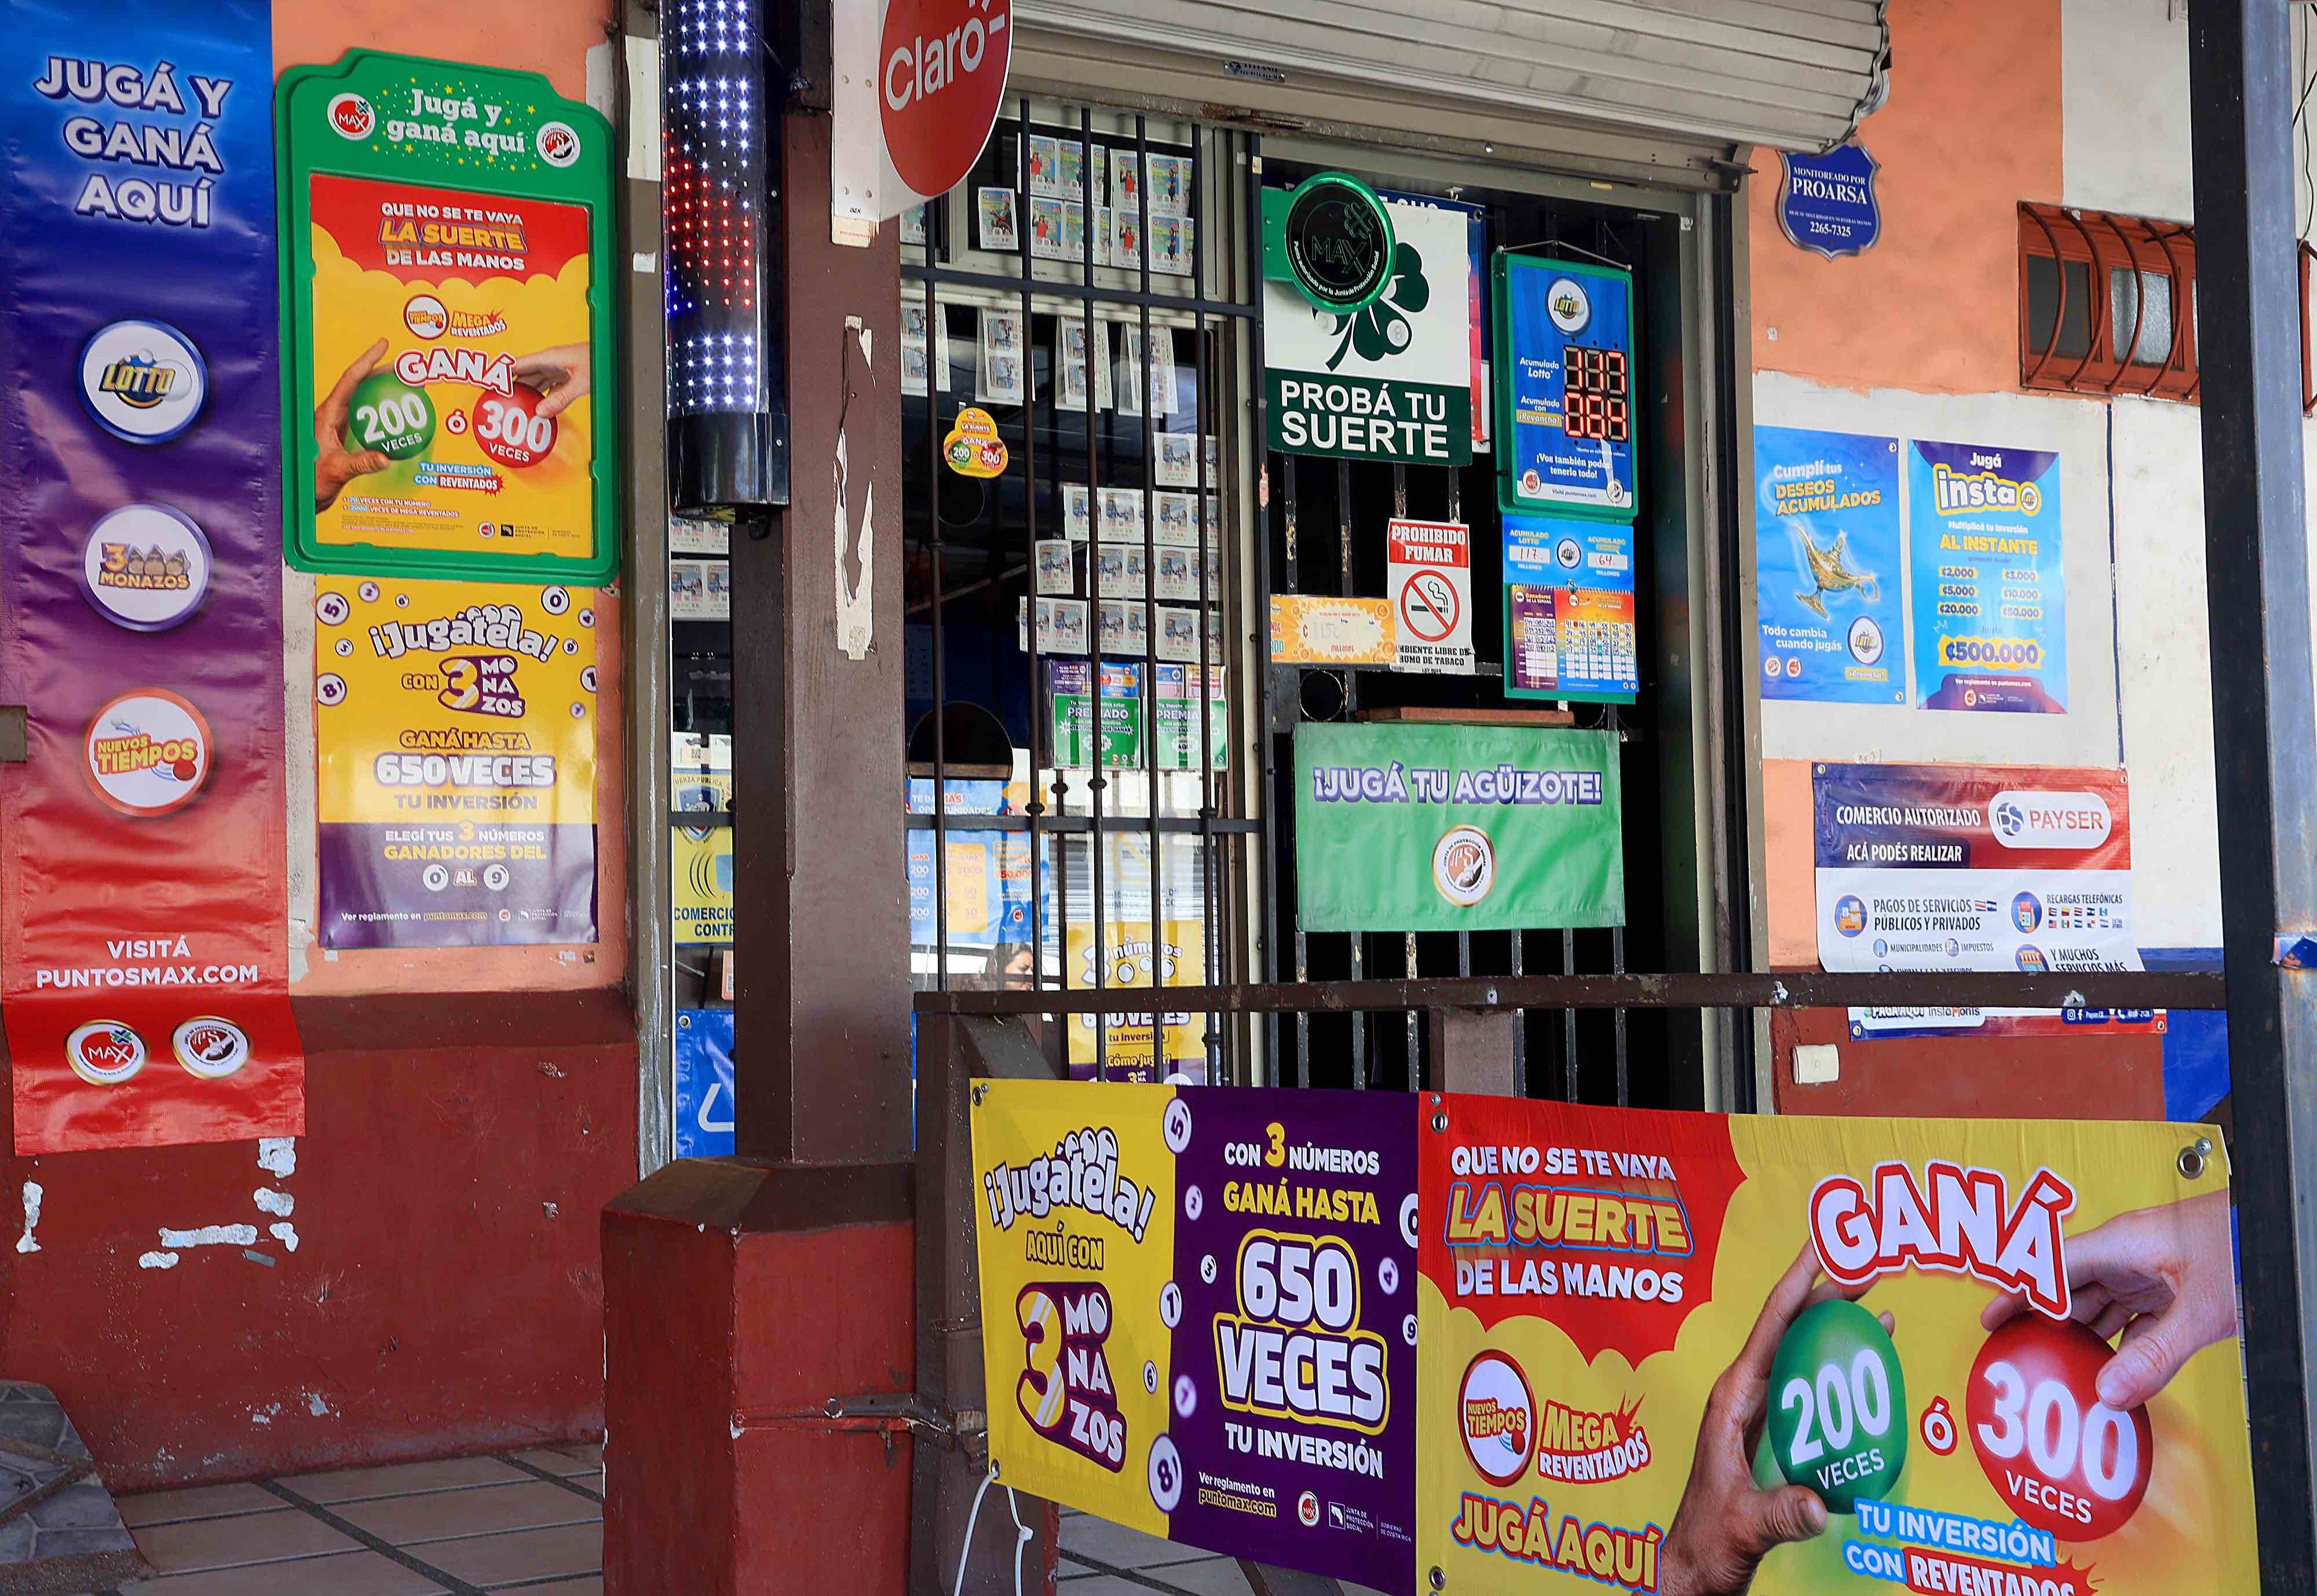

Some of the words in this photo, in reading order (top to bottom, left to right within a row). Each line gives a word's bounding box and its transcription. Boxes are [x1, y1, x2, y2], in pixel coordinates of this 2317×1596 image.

[885, 17, 986, 112] Claro
[35, 56, 184, 114] JUGÁ
[187, 76, 233, 119] Y
[411, 87, 478, 121] Jugá
[484, 103, 502, 128] y
[339, 113, 366, 131] MAX
[63, 117, 225, 174] GANÁ
[387, 118, 458, 145] ganá
[465, 129, 525, 156] aquí
[1794, 166, 1849, 182] MONITOREADO
[1850, 174, 1866, 185] POR
[76, 174, 214, 228] AQUÍ
[1792, 177, 1868, 205] PROARSA
[381, 203, 414, 217] QUE
[416, 204, 440, 218] NO
[442, 206, 462, 220] SE
[465, 208, 483, 222] TE
[486, 210, 523, 225] VAYA
[381, 220, 418, 244] LA
[422, 222, 525, 251] SUERTE
[1810, 221, 1851, 238] 2265-7325
[387, 249, 413, 265] DE
[415, 250, 453, 266] LAS
[456, 253, 525, 271] MANOS
[1311, 235, 1367, 276] MAX
[1318, 284, 1328, 293] por
[450, 319, 507, 338] REVENTADOS
[396, 348, 516, 396] GANÁ
[1519, 356, 1559, 370] Acumulado
[100, 361, 176, 397] LOTTO
[1281, 379, 1397, 418] PROBÁ
[1405, 392, 1446, 421] TU
[1521, 395, 1560, 408] Acumulado
[356, 393, 427, 444] 200
[477, 400, 551, 454] 300
[1281, 410, 1449, 459] SUERTE
[381, 432, 423, 452] VECES
[488, 442, 530, 463] VECES
[420, 462, 434, 472] TU
[436, 462, 492, 476] INVERSIÓN
[1550, 466, 1577, 476] tenerlo
[1774, 459, 1825, 480] Cumplí
[1825, 465, 1842, 474] tus
[1970, 452, 2002, 469] Jugá
[415, 474, 438, 485] CON
[440, 477, 498, 491] REVENTADOS
[1775, 479, 1836, 499] DESEOS
[1938, 470, 2017, 509] insta
[1776, 490, 1882, 516] ACUMULADOS
[1391, 525, 1466, 545] PROHIBIDO
[1510, 529, 1549, 539] ACUMULADO
[1588, 536, 1627, 545] ACUMULADO
[1939, 533, 1961, 550] AL
[1962, 535, 2038, 556] INSTANTE
[1405, 545, 1453, 563] FUMAR
[98, 571, 191, 590] MONAZOS
[368, 612, 559, 663] ¡Jugátela!
[1762, 624, 1787, 637] Todo
[1789, 626, 1827, 638] cambia
[1435, 647, 1457, 656] LIBRE
[1776, 638, 1814, 651] cuando
[1815, 638, 1842, 652] jugás
[1423, 656, 1434, 664] DE
[1434, 657, 1464, 666] TABACO
[401, 673, 439, 690] CON
[1068, 706, 1129, 720] PREADO
[97, 736, 148, 754] NUEVOS
[400, 728, 463, 749] GANÁ
[463, 731, 532, 750] HASTA
[98, 740, 196, 773] TIEMPOS
[376, 753, 446, 786] 650
[449, 755, 556, 787] VECES
[1314, 759, 1409, 804] ¡JUGÁ
[1410, 769, 1449, 804] TU
[1452, 764, 1602, 805] AGÜIZOTE!
[394, 794, 421, 810] TU
[426, 791, 538, 810] INVERSIÓN
[1836, 805, 1902, 826] COMERCIO
[1905, 807, 1982, 827] AUTORIZADO
[2030, 810, 2104, 830] PAYSER
[385, 827, 425, 842] ELEGÍ
[427, 830, 454, 842] TUS
[458, 821, 475, 842] 3
[478, 827, 544, 842] NÚMEROS
[384, 845, 506, 861] GANADORES
[510, 845, 547, 861] DEL
[1847, 841, 1869, 861] ACÁ
[1872, 843, 1907, 861] PODÉS
[1910, 845, 1962, 863] REALIZAR
[454, 870, 477, 887] AL
[1874, 899, 1906, 913] PAGOS
[1908, 899, 1921, 912] DE
[1923, 899, 1972, 913] SERVICIOS
[2046, 894, 2081, 904] RECARGAS
[2081, 892, 2123, 904] TELEFÓNICAS
[341, 912, 357, 921] Ver
[358, 910, 408, 923] reglamento
[410, 913, 422, 921] en
[1874, 914, 1925, 932] PÚBLICOS
[1925, 917, 1932, 930] Y
[1933, 916, 1981, 931] PRIVADOS
[107, 934, 191, 960] VISITÁ
[1890, 943, 1943, 953] MUNICIPALIDADES
[1961, 943, 1994, 952] IMPUESTOS
[2050, 949, 2057, 960] Y
[2059, 948, 2100, 960] MUCHOS
[36, 965, 259, 988] PUNTOSMAX.COM
[1109, 1033, 1119, 1042] tu
[87, 1045, 131, 1064] MAX
[1224, 1142, 1260, 1167] CON
[1265, 1122, 1285, 1167] 3
[1289, 1141, 1380, 1175] NÚMEROS
[1452, 1145, 1499, 1176] QUE
[1502, 1146, 1540, 1175] NO
[1544, 1147, 1578, 1176] SE
[1580, 1148, 1611, 1177] TE
[1612, 1152, 1678, 1182] VAYA
[984, 1142, 1156, 1244] ¡Jugátela!
[1223, 1177, 1292, 1217] GANÁ
[1296, 1187, 1380, 1225] HASTA
[1449, 1188, 1507, 1240] LA
[1513, 1190, 1688, 1250] SUERTE
[1025, 1221, 1065, 1266] AQUÍ
[1066, 1235, 1104, 1270] CON
[1814, 1166, 2070, 1314] GANÁ
[1242, 1241, 1353, 1328] 650
[1456, 1259, 1494, 1296] DE
[1501, 1259, 1559, 1296] LAS
[1562, 1262, 1684, 1305] MANOS
[1219, 1325, 1384, 1422] VECES
[1467, 1401, 1497, 1416] NUEVOS
[1468, 1409, 1526, 1437] TIEMPOS
[1544, 1403, 1620, 1451] MEGA
[1781, 1347, 1891, 1467] 200
[1976, 1359, 2139, 1502] 300
[1225, 1422, 1252, 1453] TU
[1258, 1428, 1384, 1480] INVERSIÓN
[1539, 1429, 1649, 1481] REVENTADOS
[1198, 1471, 1213, 1484] Ver
[1214, 1476, 1261, 1496] reglamento
[1263, 1487, 1275, 1498] en
[1817, 1448, 1886, 1491] VECES
[2005, 1469, 2093, 1525] VECES
[1198, 1487, 1277, 1518] puntomax.com
[1452, 1496, 1552, 1565] JUGÁ
[1556, 1519, 1662, 1590] AQUÍ
[1857, 1503, 1891, 1532] TU
[1899, 1511, 2051, 1563] INVERSIÓN
[1846, 1545, 1903, 1579] CON
